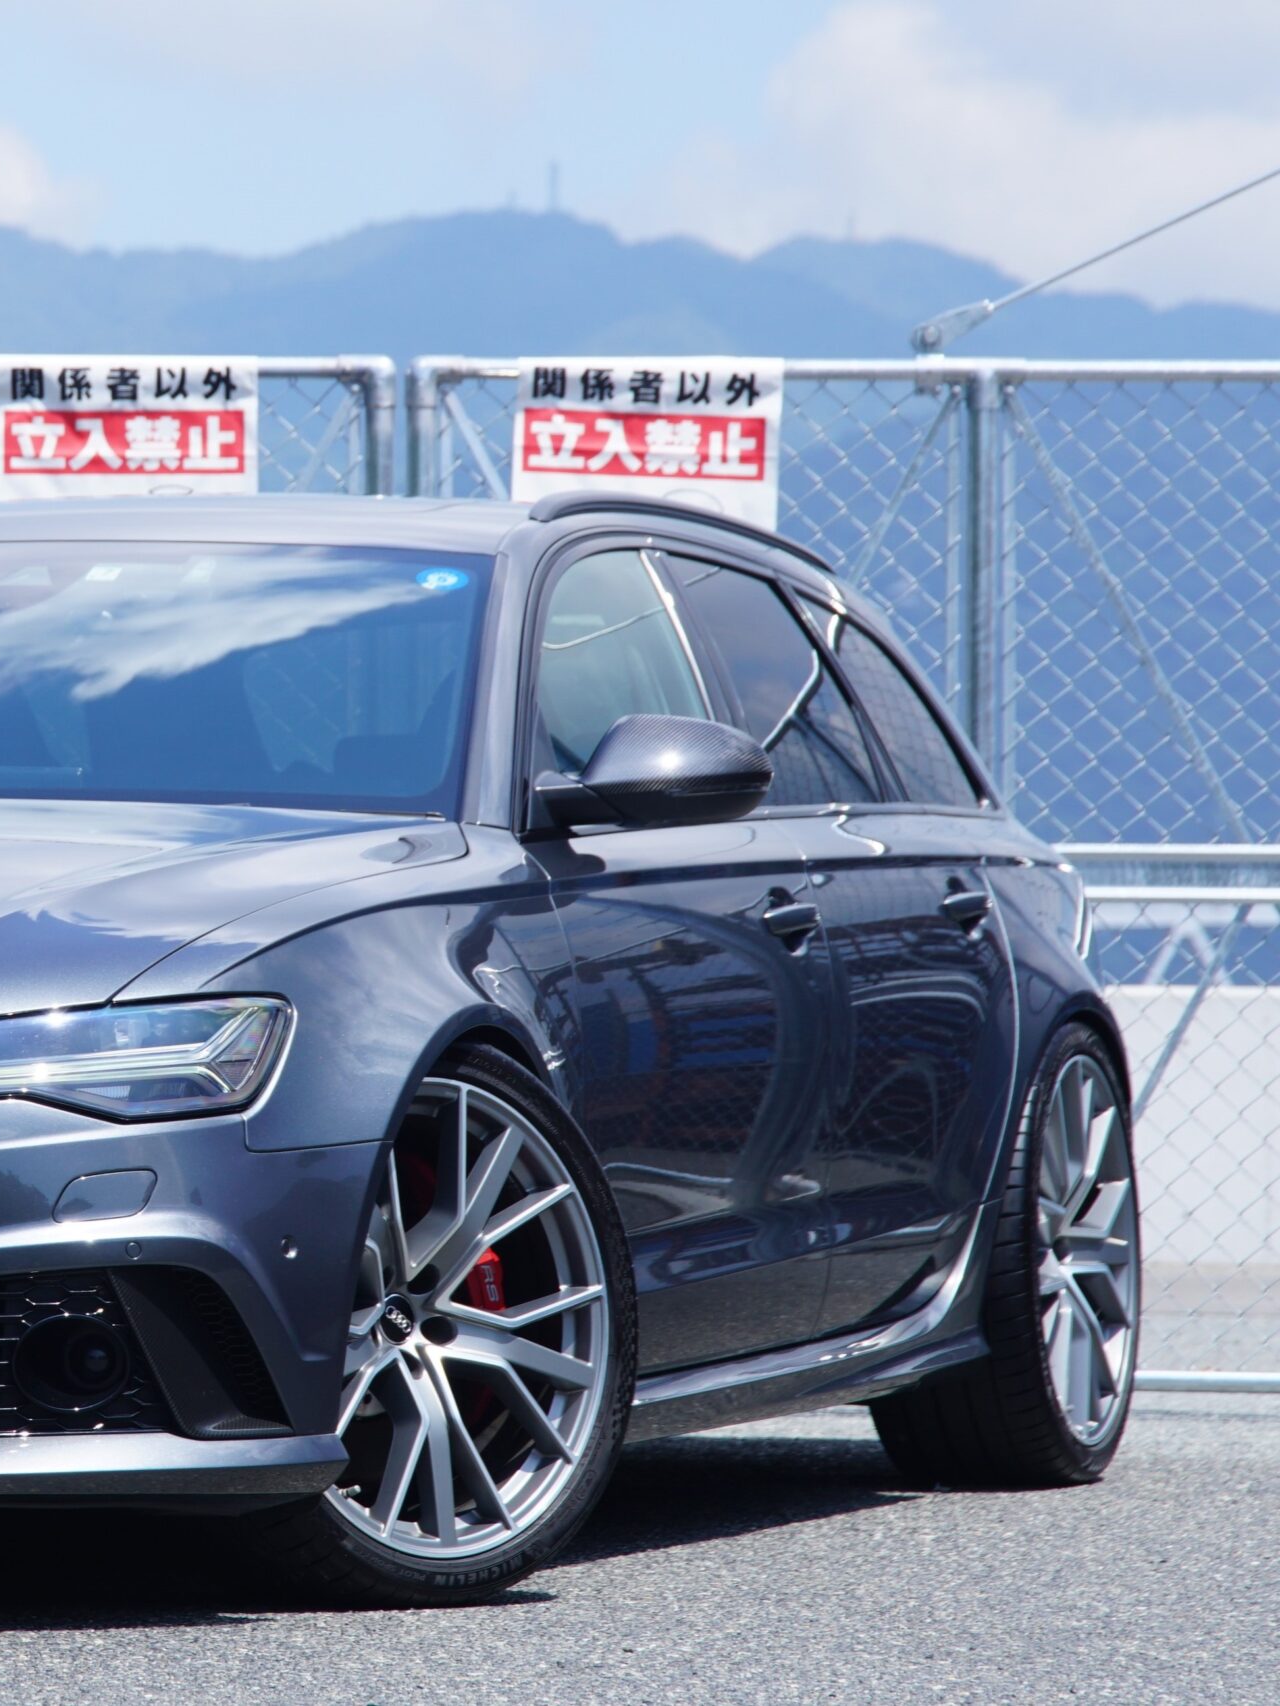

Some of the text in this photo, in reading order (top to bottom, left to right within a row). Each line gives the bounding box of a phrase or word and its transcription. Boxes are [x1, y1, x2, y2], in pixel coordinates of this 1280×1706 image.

[11, 367, 237, 401] 関係者以外
[532, 367, 761, 406] 関係者以外
[10, 416, 239, 471] 立入禁止
[527, 414, 759, 477] 立入禁止
[480, 1265, 499, 1302] RS
[433, 1557, 524, 1587] MICHELIN
